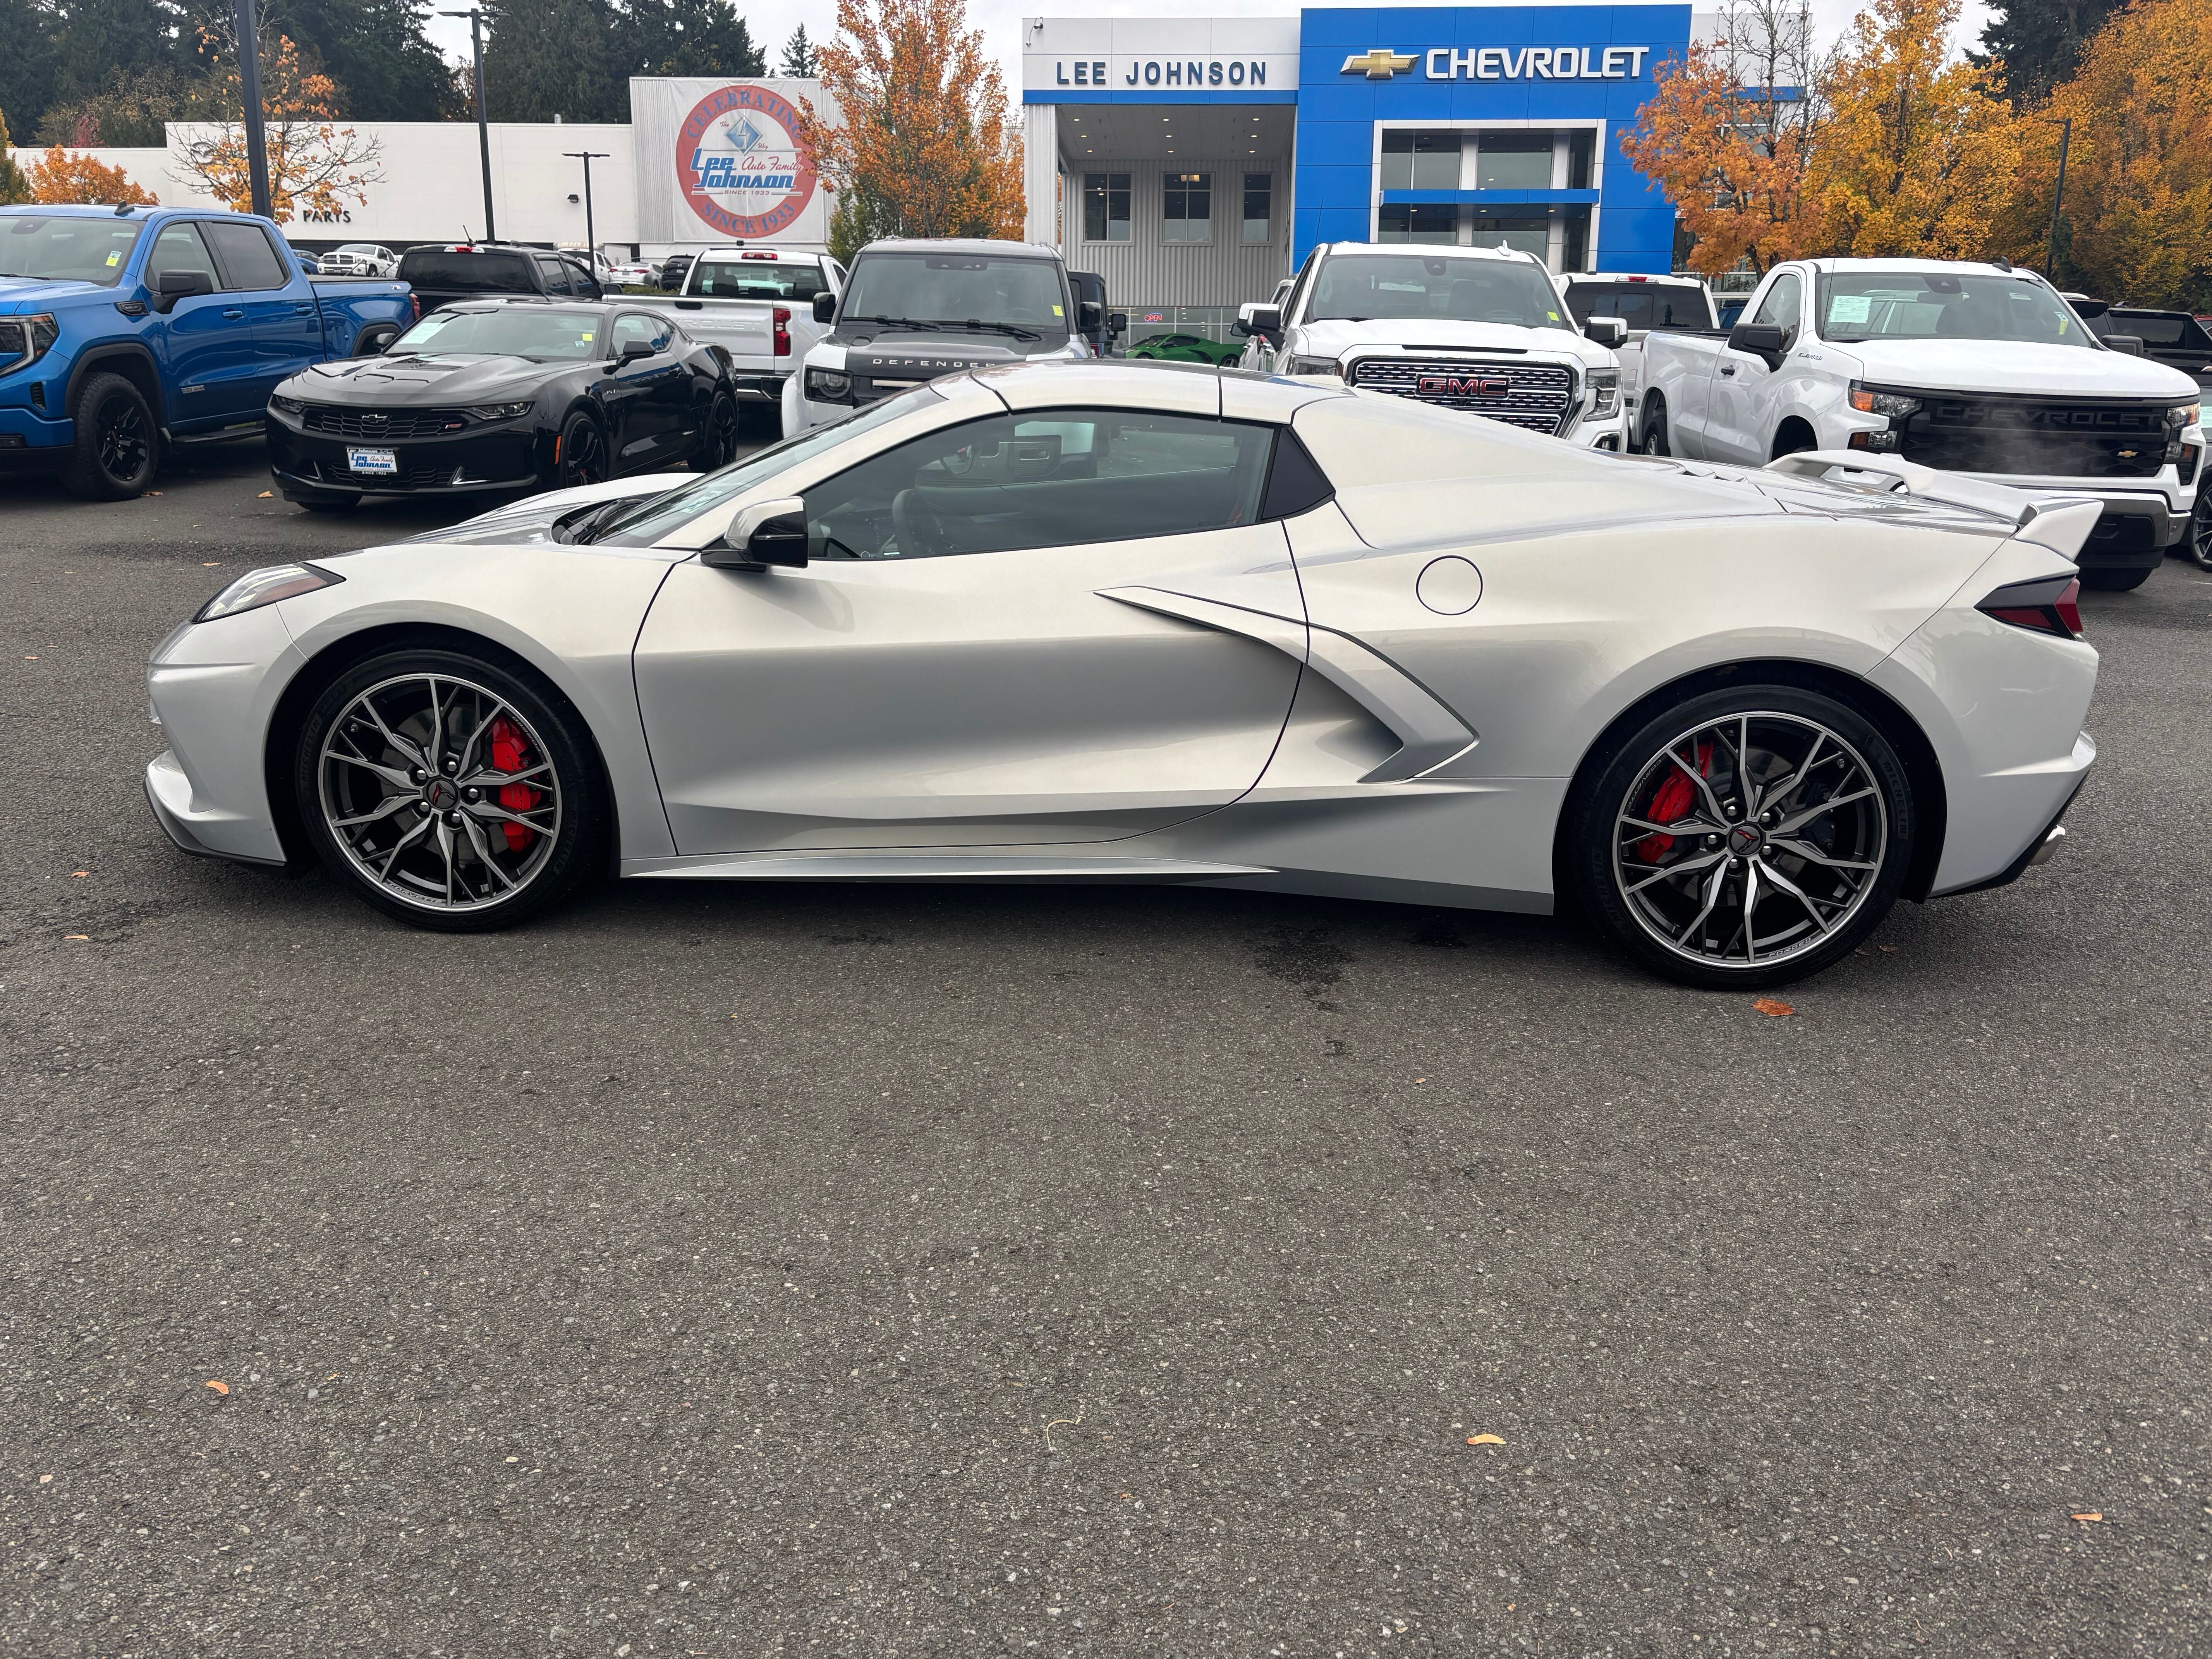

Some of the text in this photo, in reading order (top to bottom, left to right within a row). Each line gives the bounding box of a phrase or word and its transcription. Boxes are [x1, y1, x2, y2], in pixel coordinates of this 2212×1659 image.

[1057, 62, 1266, 85] LEE JOHNSON
[1426, 47, 1649, 79] CHEVROLET
[687, 91, 803, 138] CELEBRATING
[691, 148, 804, 177] Lee Auto Family
[694, 167, 795, 188] Johnson
[701, 203, 794, 234] SINCE 1933
[1420, 378, 1506, 396] GMC
[1937, 406, 2164, 426] CHEVROLET
[351, 452, 368, 460] Lee
[353, 460, 392, 468] Johnson
[1882, 761, 1908, 834] MICHELIN
[1769, 938, 1811, 957] FORGED
